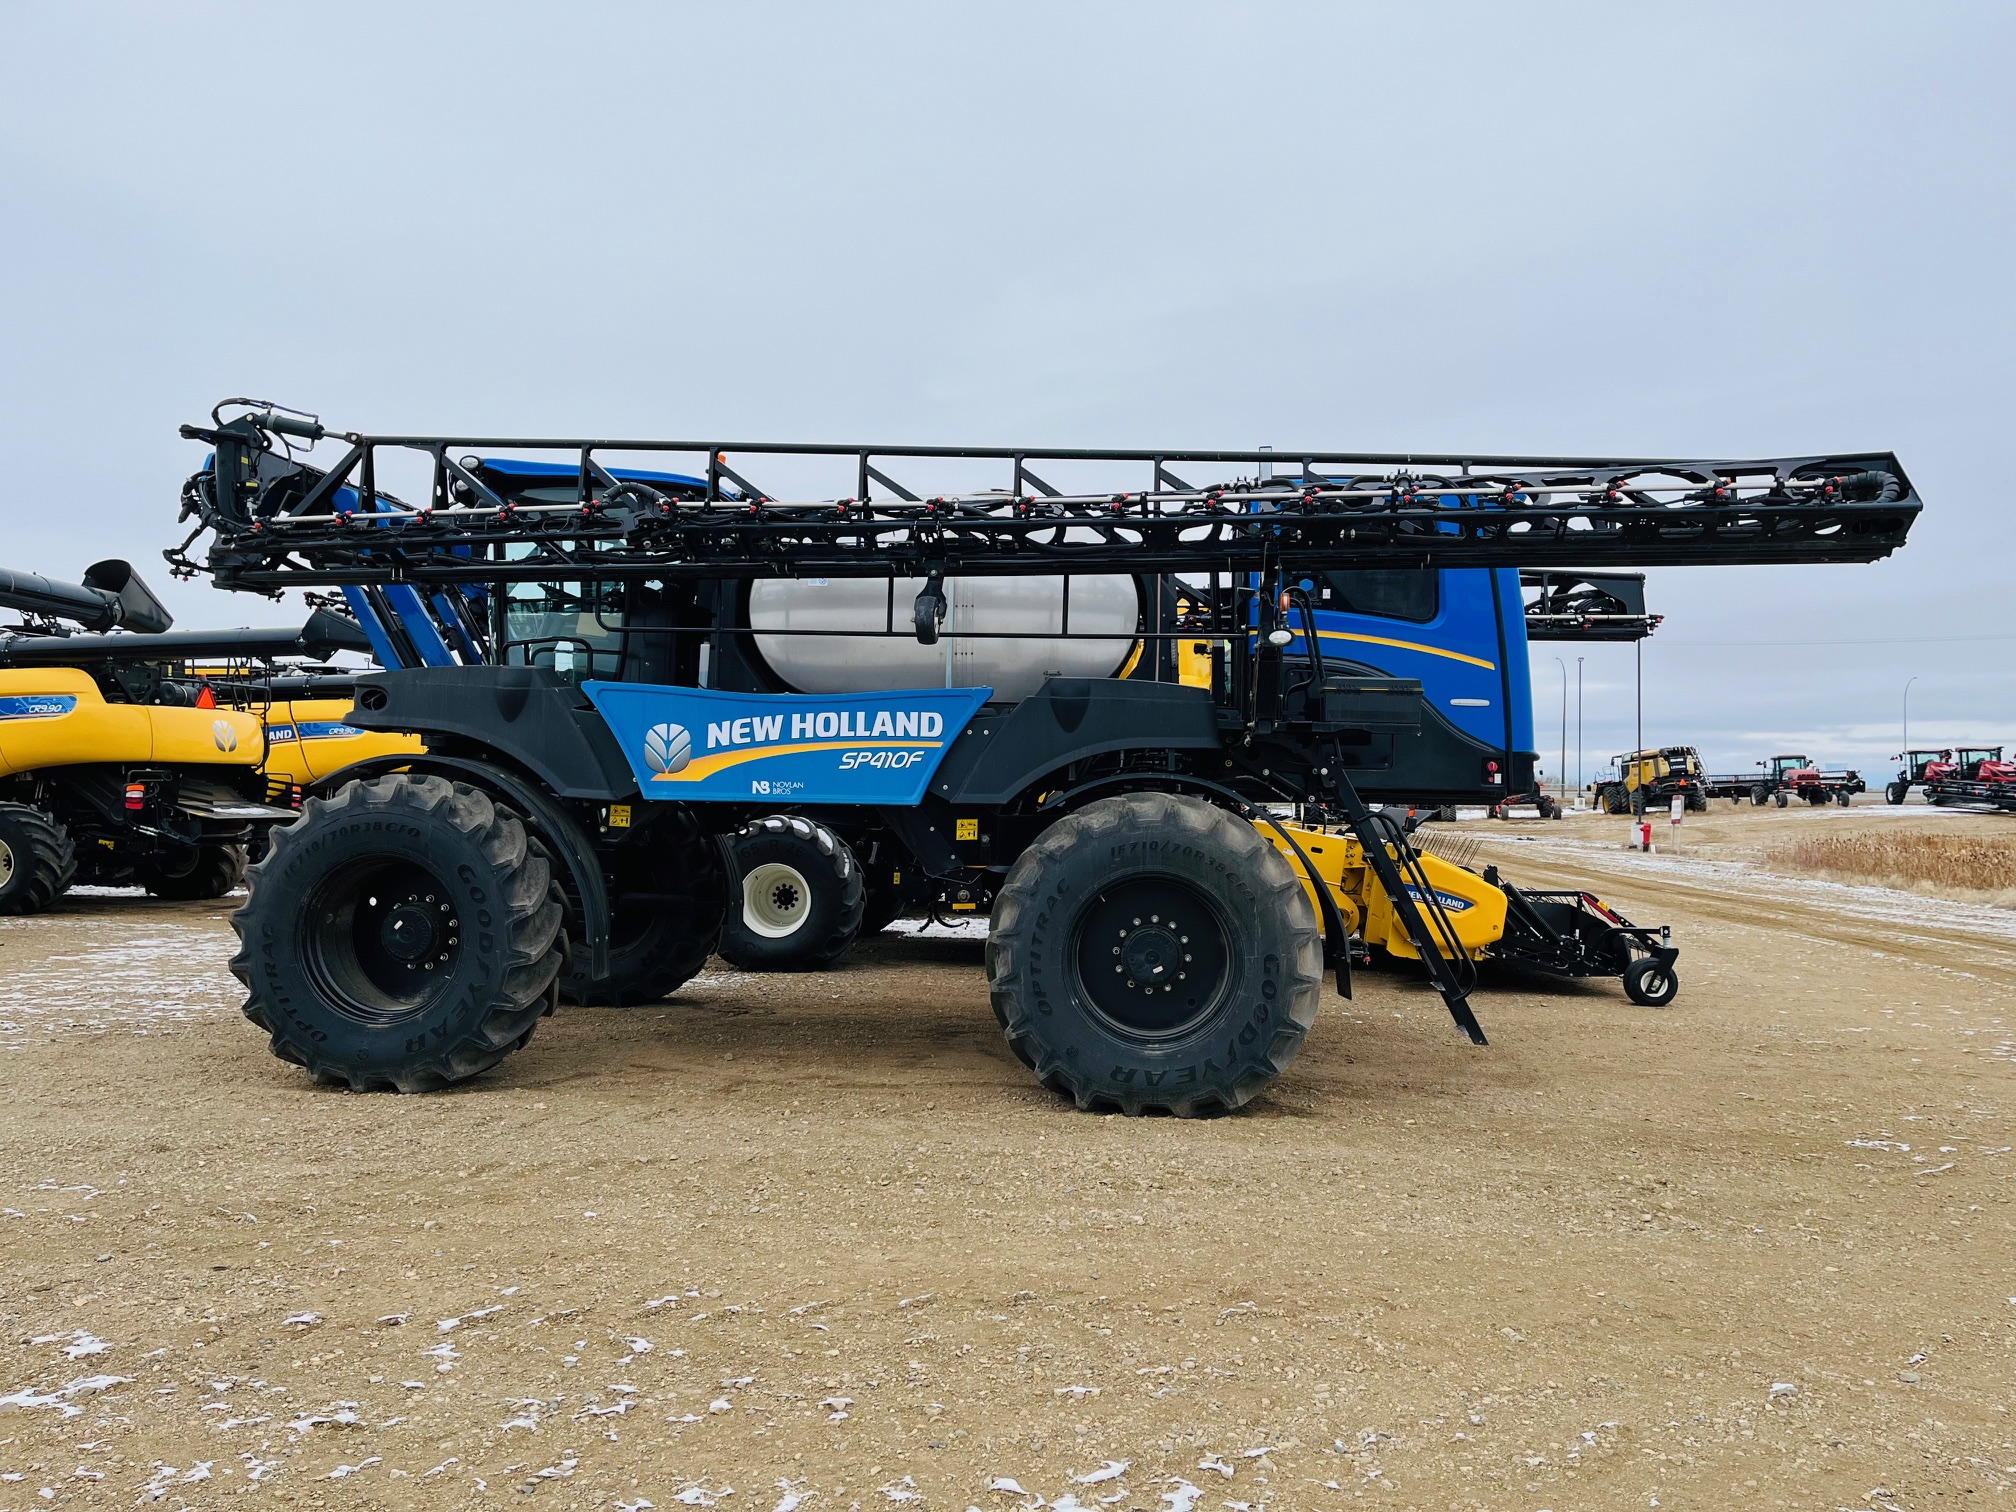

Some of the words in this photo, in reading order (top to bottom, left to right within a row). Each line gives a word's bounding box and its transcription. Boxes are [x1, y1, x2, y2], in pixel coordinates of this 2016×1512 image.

[28, 704, 62, 713] CR9.90
[707, 714, 784, 749] NEW
[791, 711, 944, 738] HOLLAND
[838, 750, 925, 770] SP410F
[752, 780, 771, 794] NB
